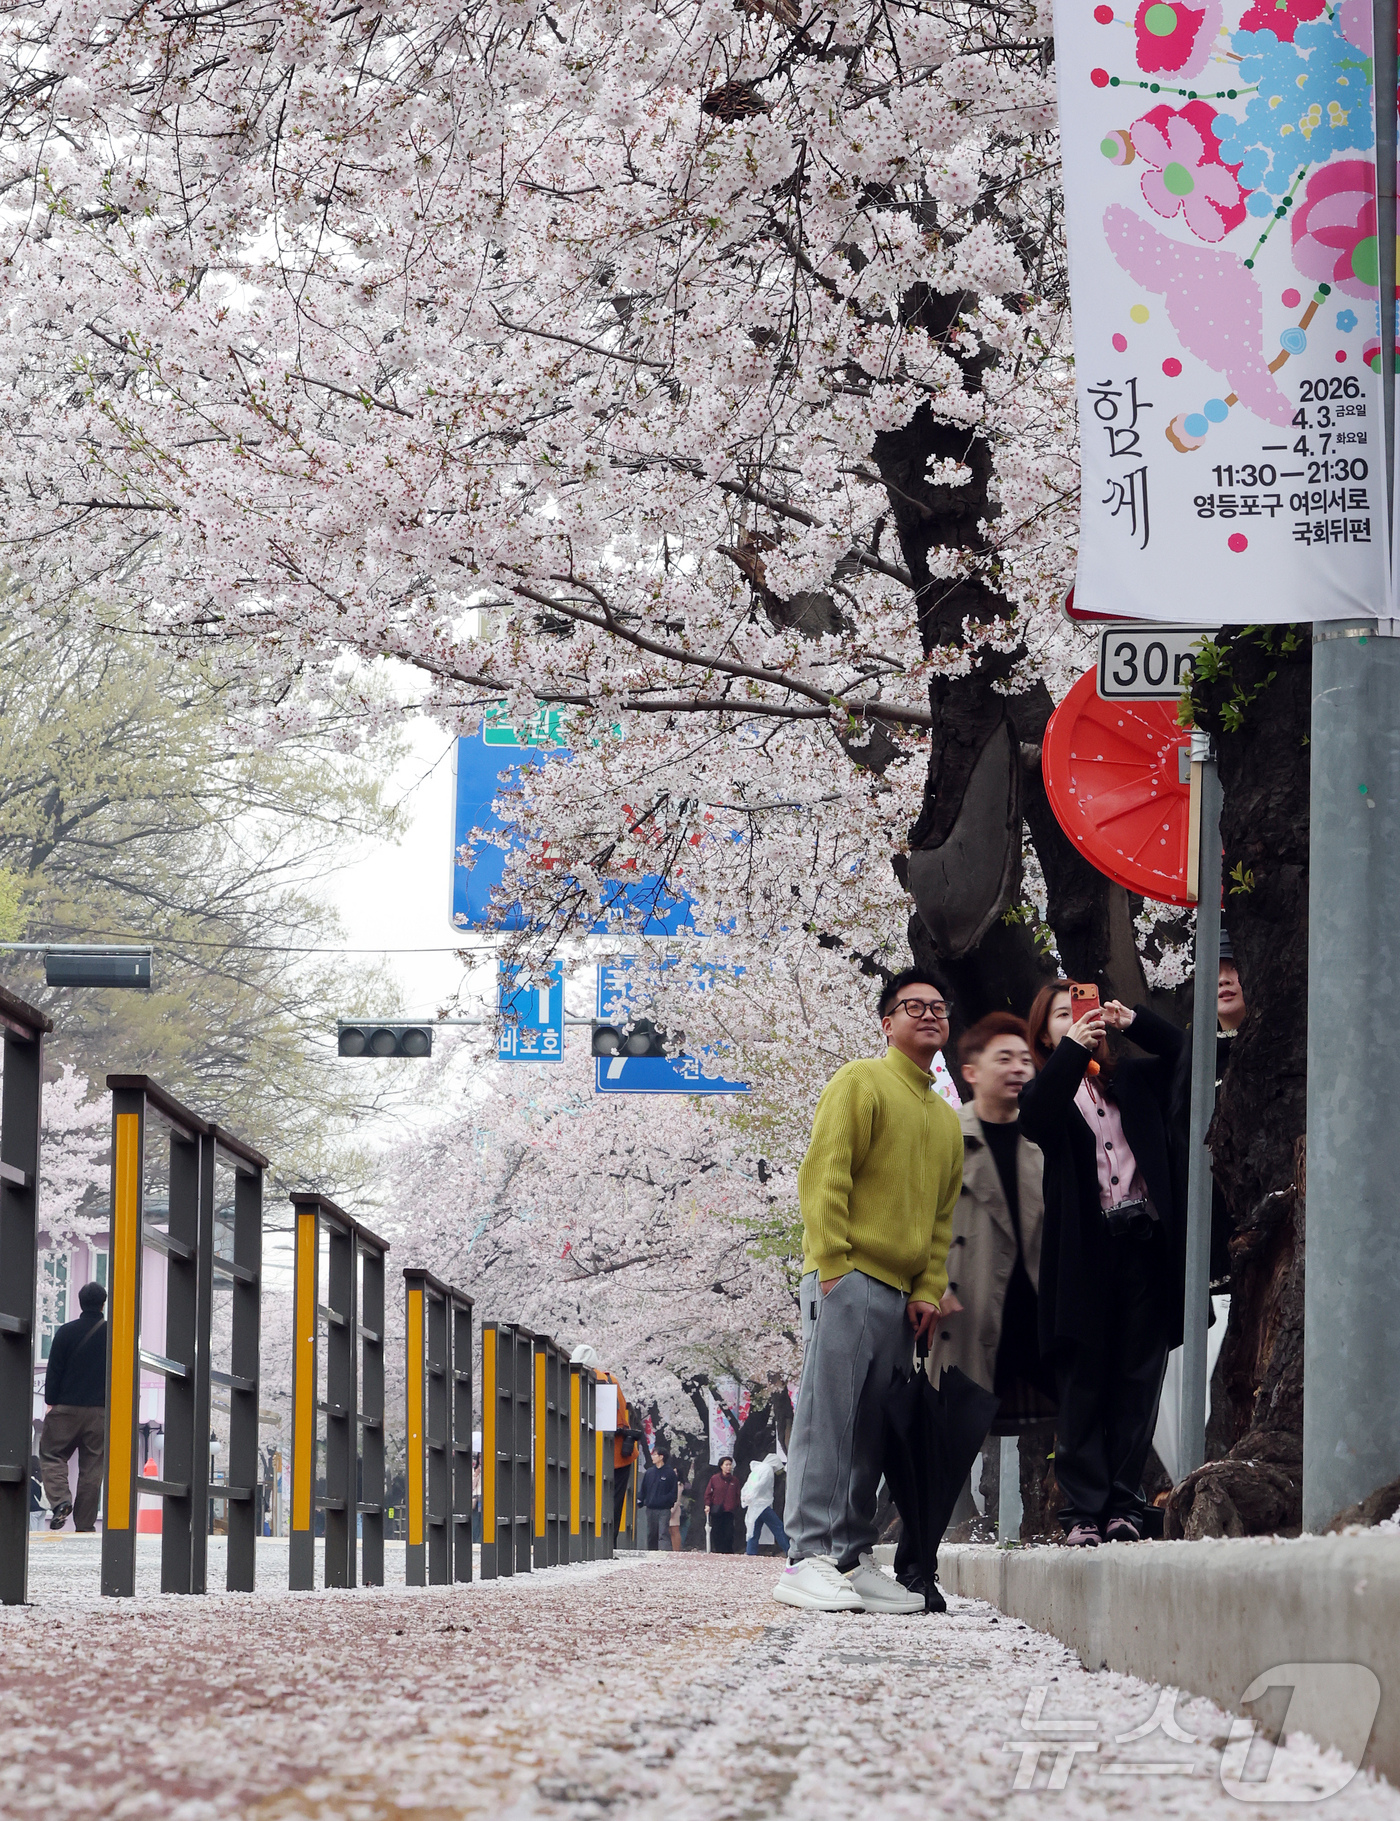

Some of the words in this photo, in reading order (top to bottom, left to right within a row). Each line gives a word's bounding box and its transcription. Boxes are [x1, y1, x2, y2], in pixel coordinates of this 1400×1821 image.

[1299, 376, 1366, 402] 2026.
[1335, 404, 1367, 418] 금요일
[1336, 431, 1368, 445] 화요일
[1087, 377, 1154, 550] 함께
[1193, 493, 1284, 519] 영등포구
[1289, 487, 1370, 516] 여의서로
[1292, 517, 1372, 546] 국회뒤편
